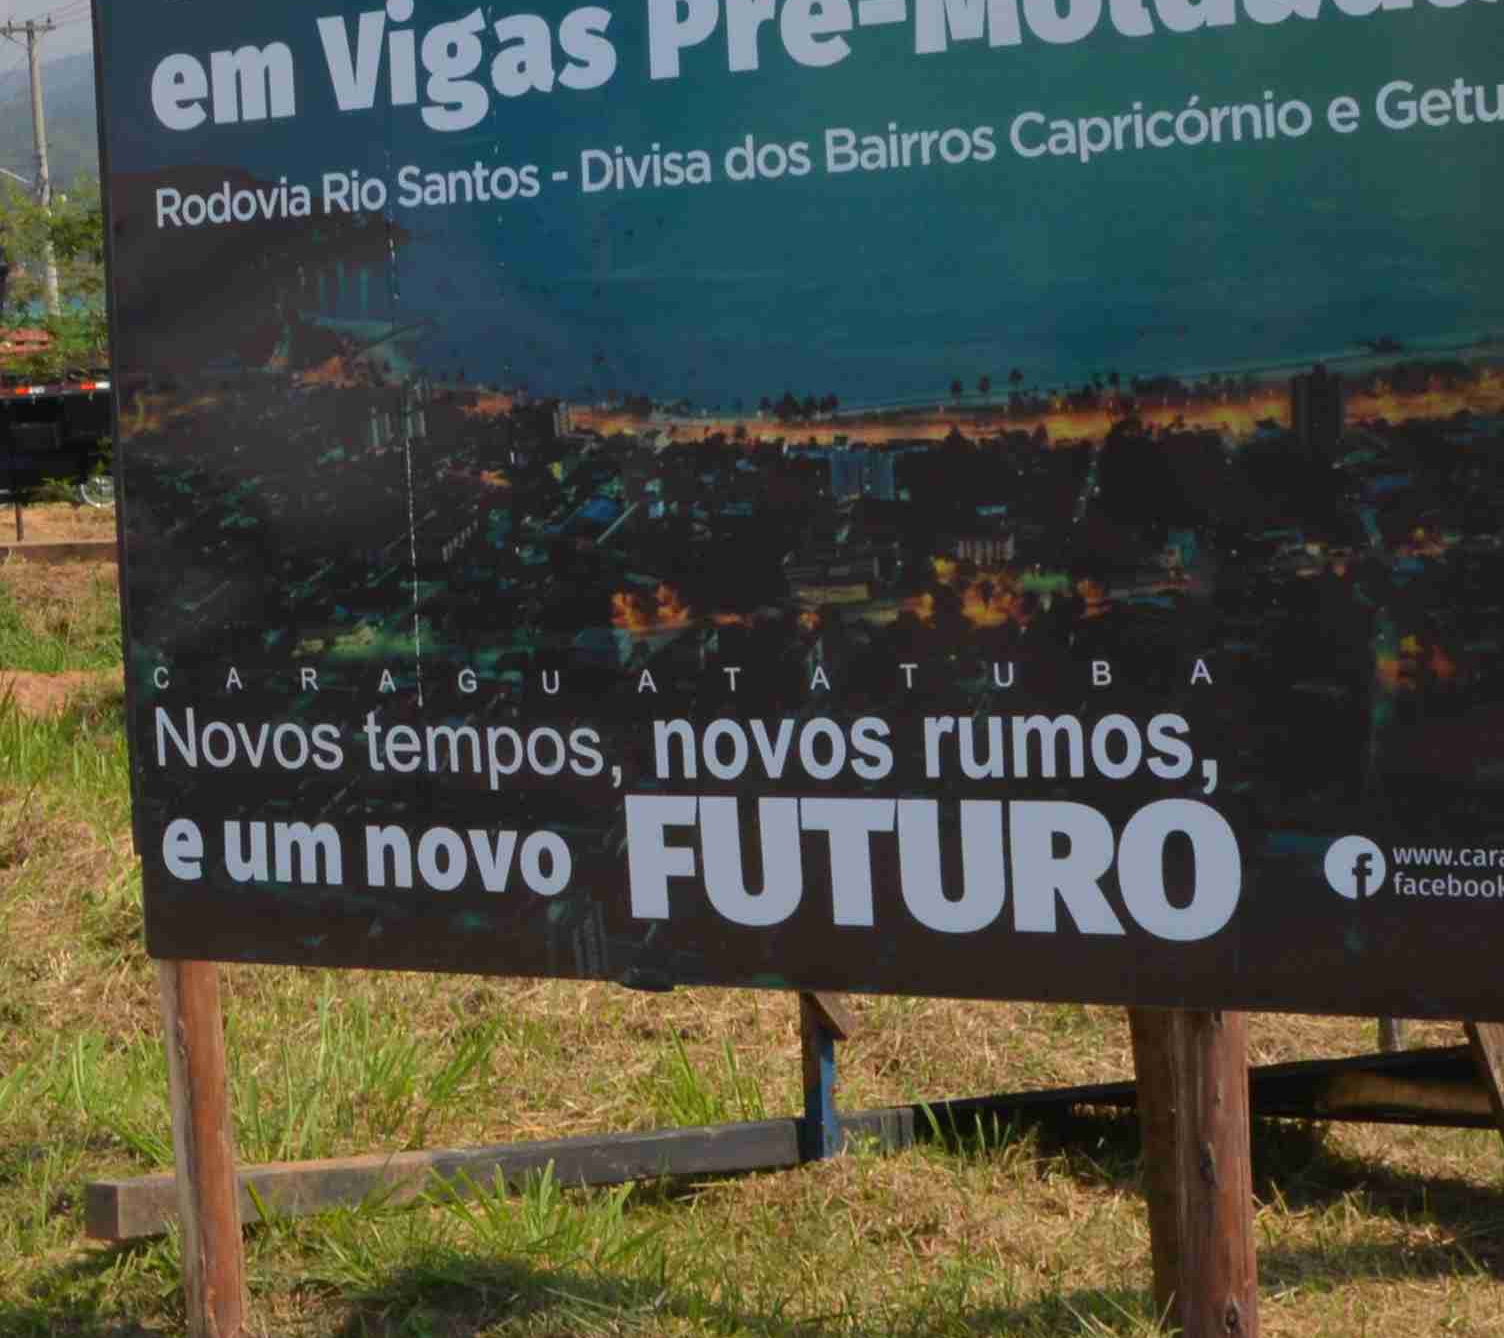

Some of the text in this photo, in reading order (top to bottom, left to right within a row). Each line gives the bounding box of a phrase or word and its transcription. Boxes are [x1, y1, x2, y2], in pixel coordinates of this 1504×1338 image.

[150, 41, 297, 132] em
[155, 173, 312, 229] Rodovia
[321, 168, 388, 215] Rio
[396, 160, 541, 208] Santos
[580, 144, 713, 193] Divisa
[723, 133, 812, 182] dos
[824, 123, 998, 174] Bairros
[1008, 92, 1314, 164] Capricórnio
[1326, 95, 1361, 134] e
[154, 706, 1219, 796] Novos tempos, novos rumos,
[161, 793, 1242, 942] e um novo FUTURO
